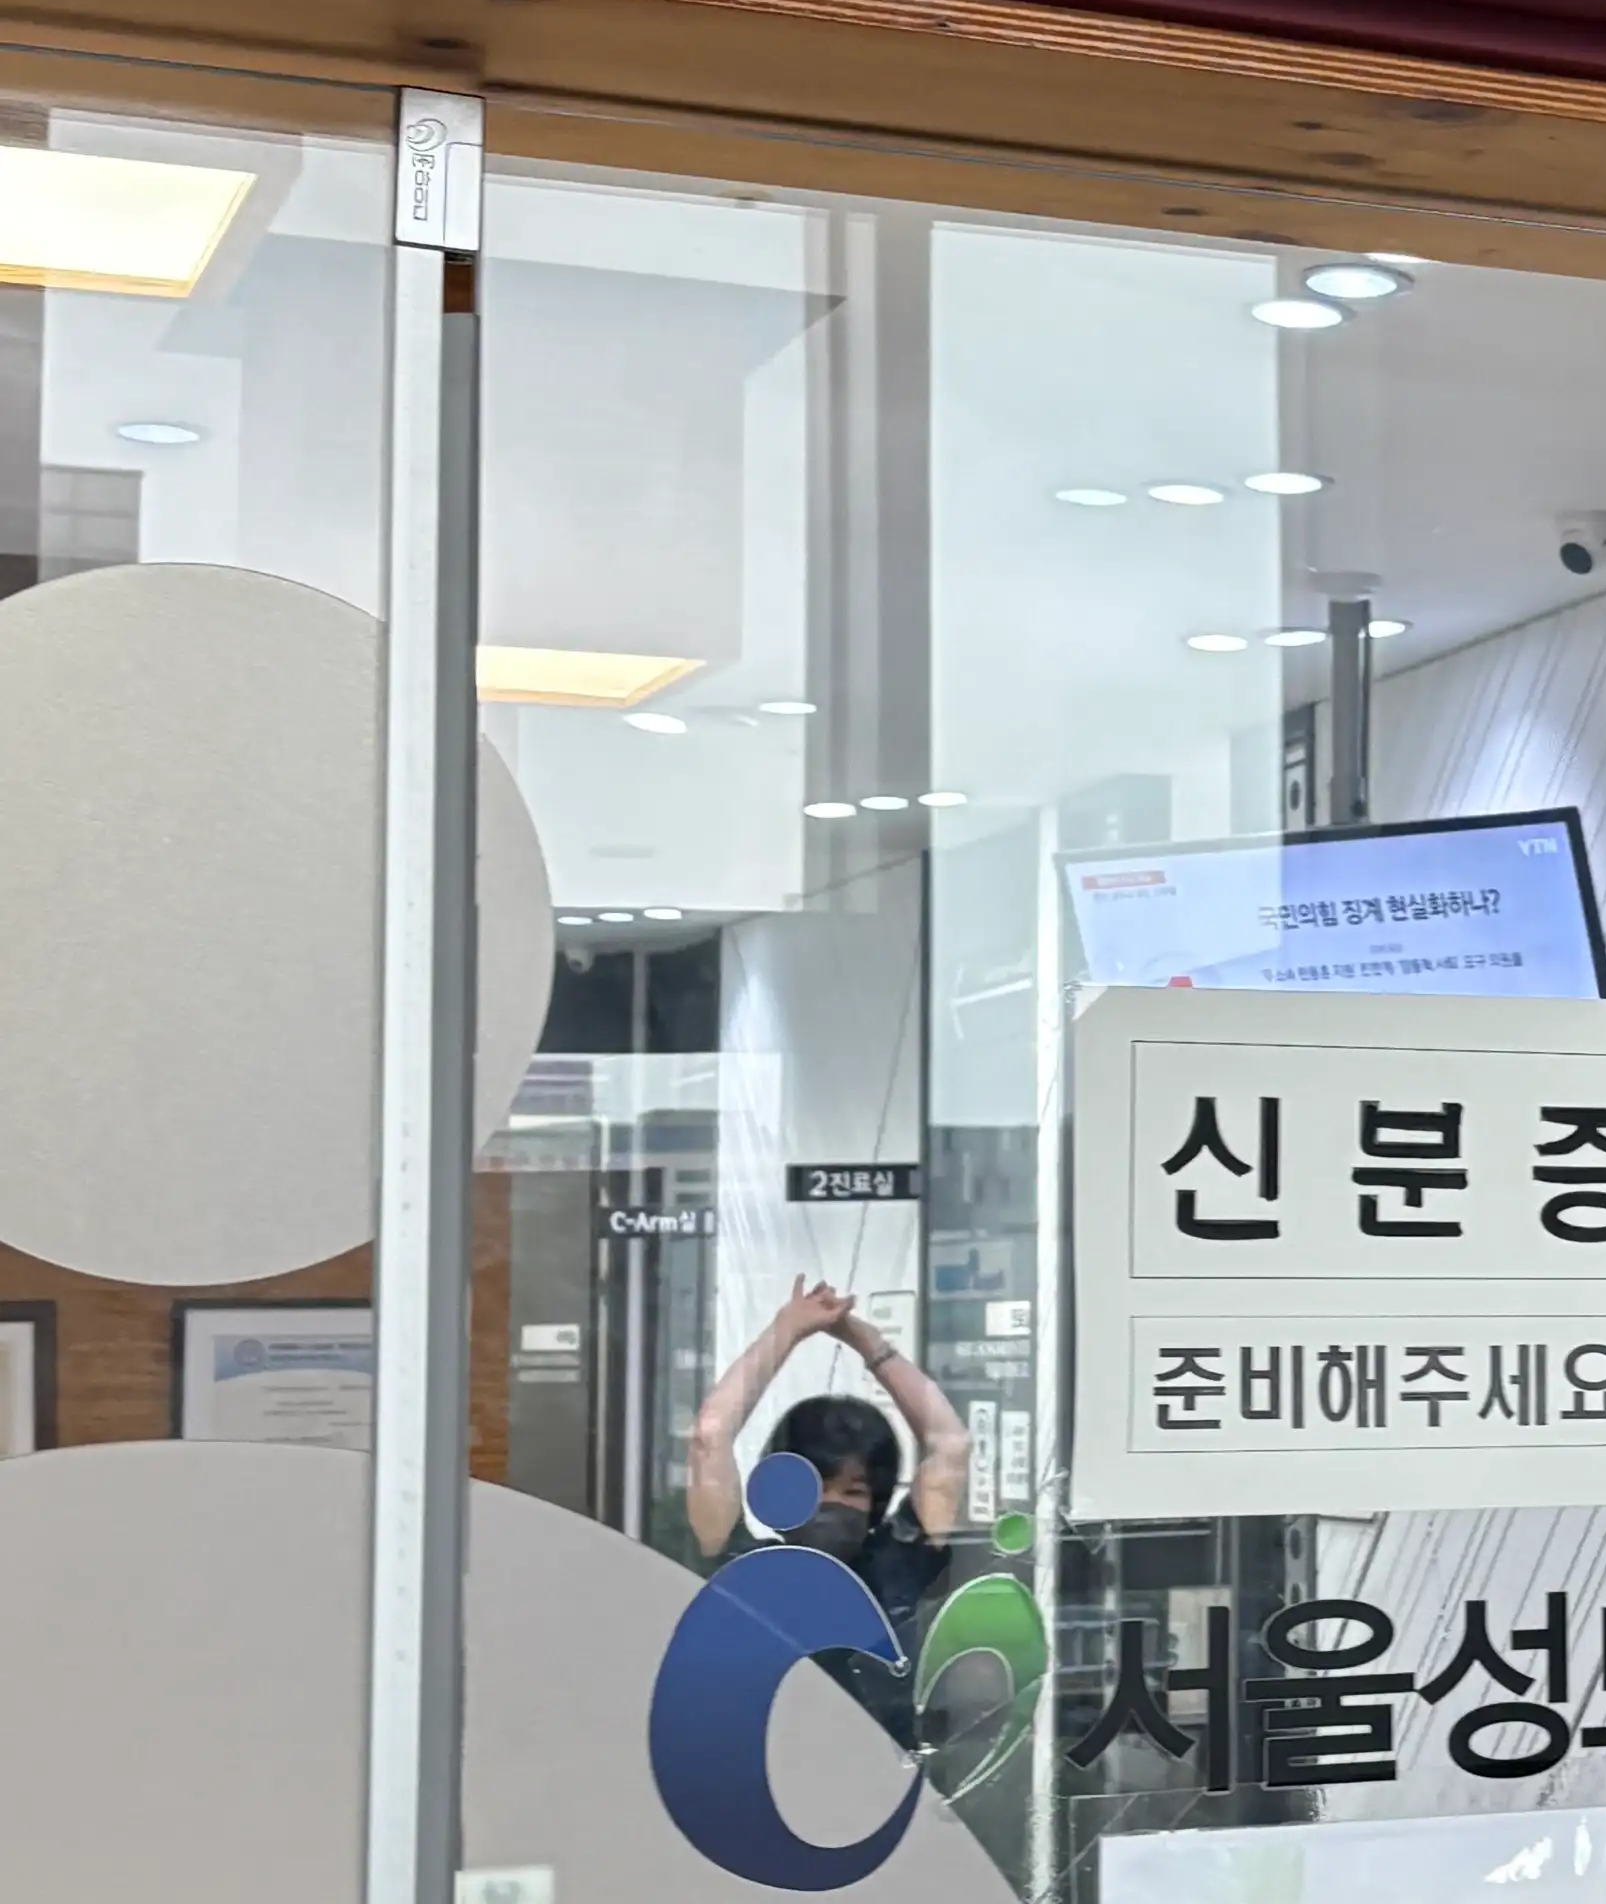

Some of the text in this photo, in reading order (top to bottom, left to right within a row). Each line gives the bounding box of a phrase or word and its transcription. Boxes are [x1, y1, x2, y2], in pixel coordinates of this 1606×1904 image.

[1516, 837, 1558, 857] YTN
[1258, 888, 1501, 931] 국민의힘 징계 현실화하나?
[808, 1170, 896, 1198] 2진료실
[609, 1210, 697, 1235] C-Arm실
